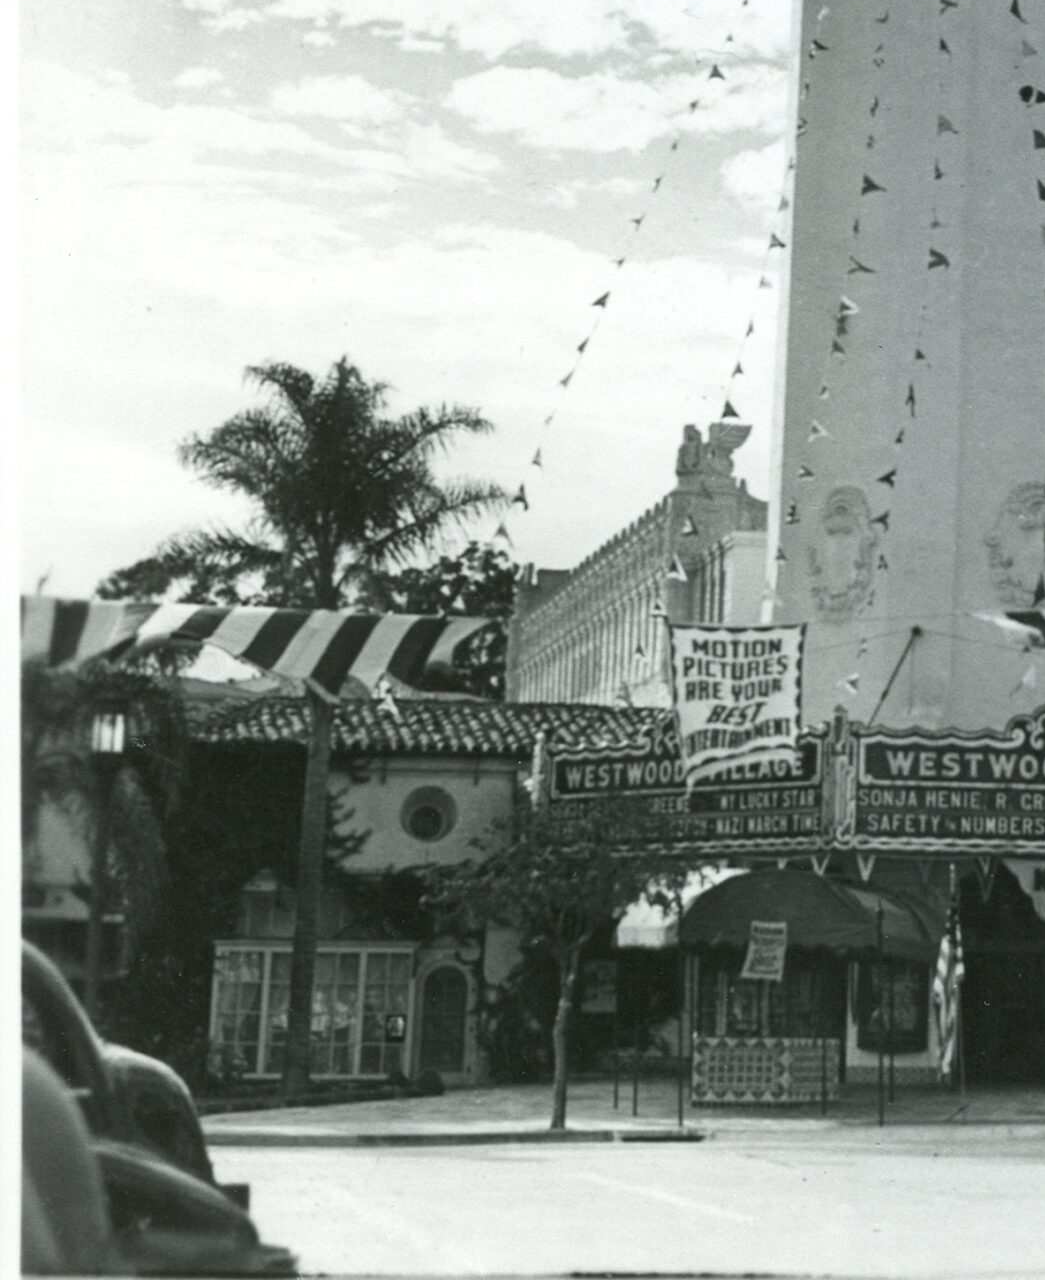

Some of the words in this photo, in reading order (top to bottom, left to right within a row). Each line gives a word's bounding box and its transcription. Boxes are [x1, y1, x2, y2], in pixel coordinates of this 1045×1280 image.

[692, 638, 782, 658] MOTION
[683, 655, 789, 680] PICTURES
[686, 680, 723, 701] ARE
[731, 677, 782, 702] YOUR
[706, 702, 767, 726] BEST
[566, 758, 686, 789] WESTWOOD
[858, 789, 918, 807] SONJA
